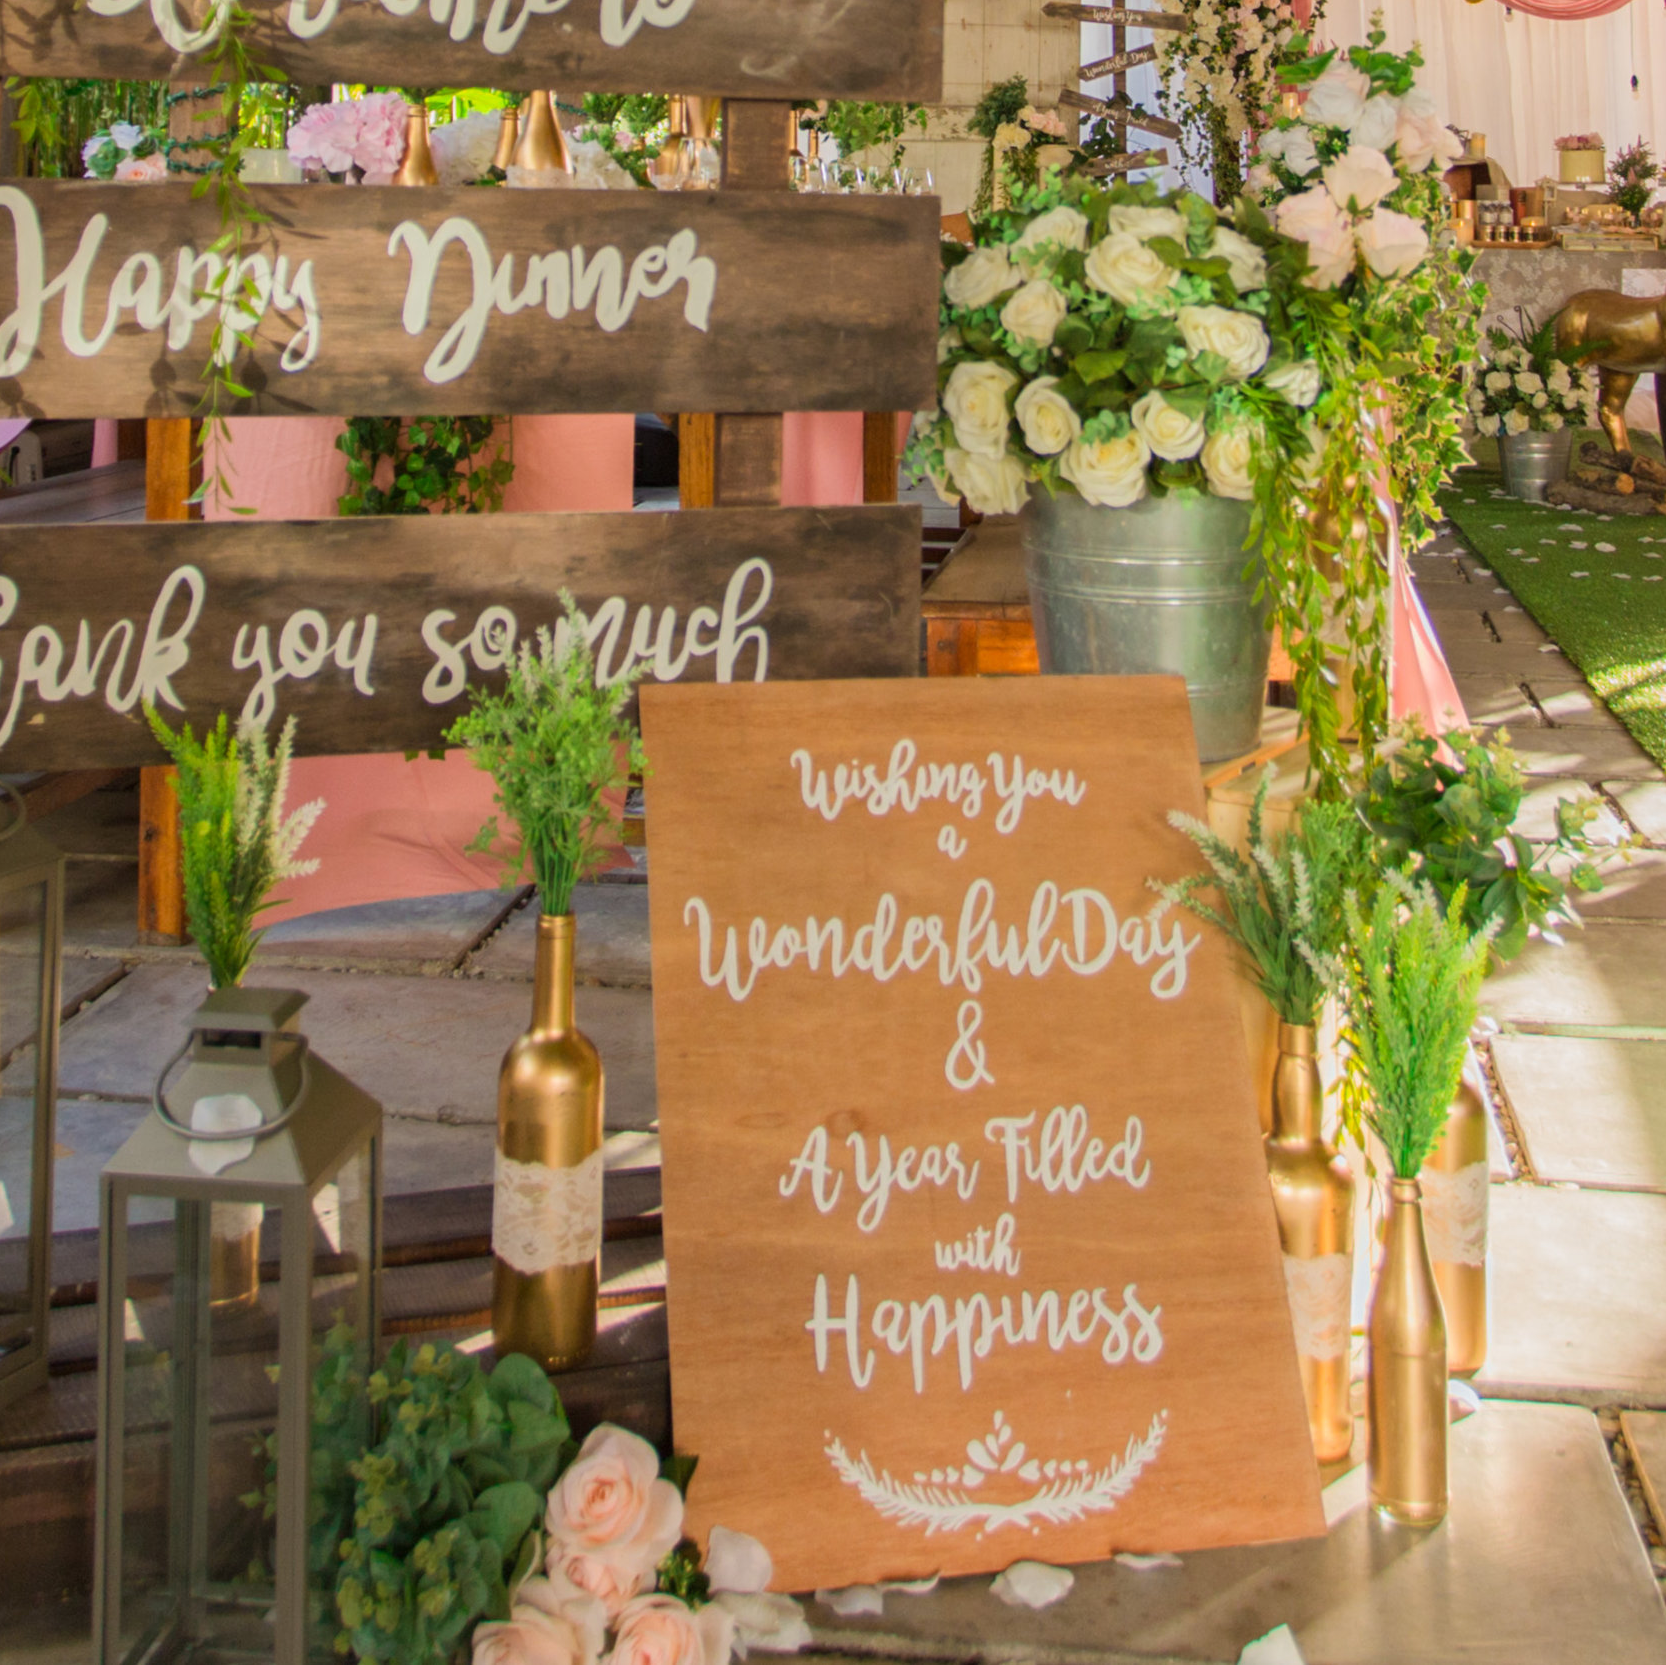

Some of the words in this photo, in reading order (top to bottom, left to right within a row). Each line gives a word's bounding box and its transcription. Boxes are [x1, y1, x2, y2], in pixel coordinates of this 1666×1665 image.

[387, 216, 717, 383] Dinner
[231, 608, 378, 731] you
[421, 604, 518, 705] so
[553, 557, 773, 690] much
[790, 738, 986, 820] Wishing
[987, 751, 1086, 834] You
[937, 824, 967, 859] a
[683, 878, 1060, 1002] Wonderful
[1060, 886, 1201, 999] Day
[944, 999, 996, 1090] &
[779, 1125, 844, 1213] A
[846, 1131, 980, 1232] Year
[984, 1103, 1151, 1204] Filled
[934, 1212, 1021, 1276] with
[804, 1272, 1164, 1395] Happiness
